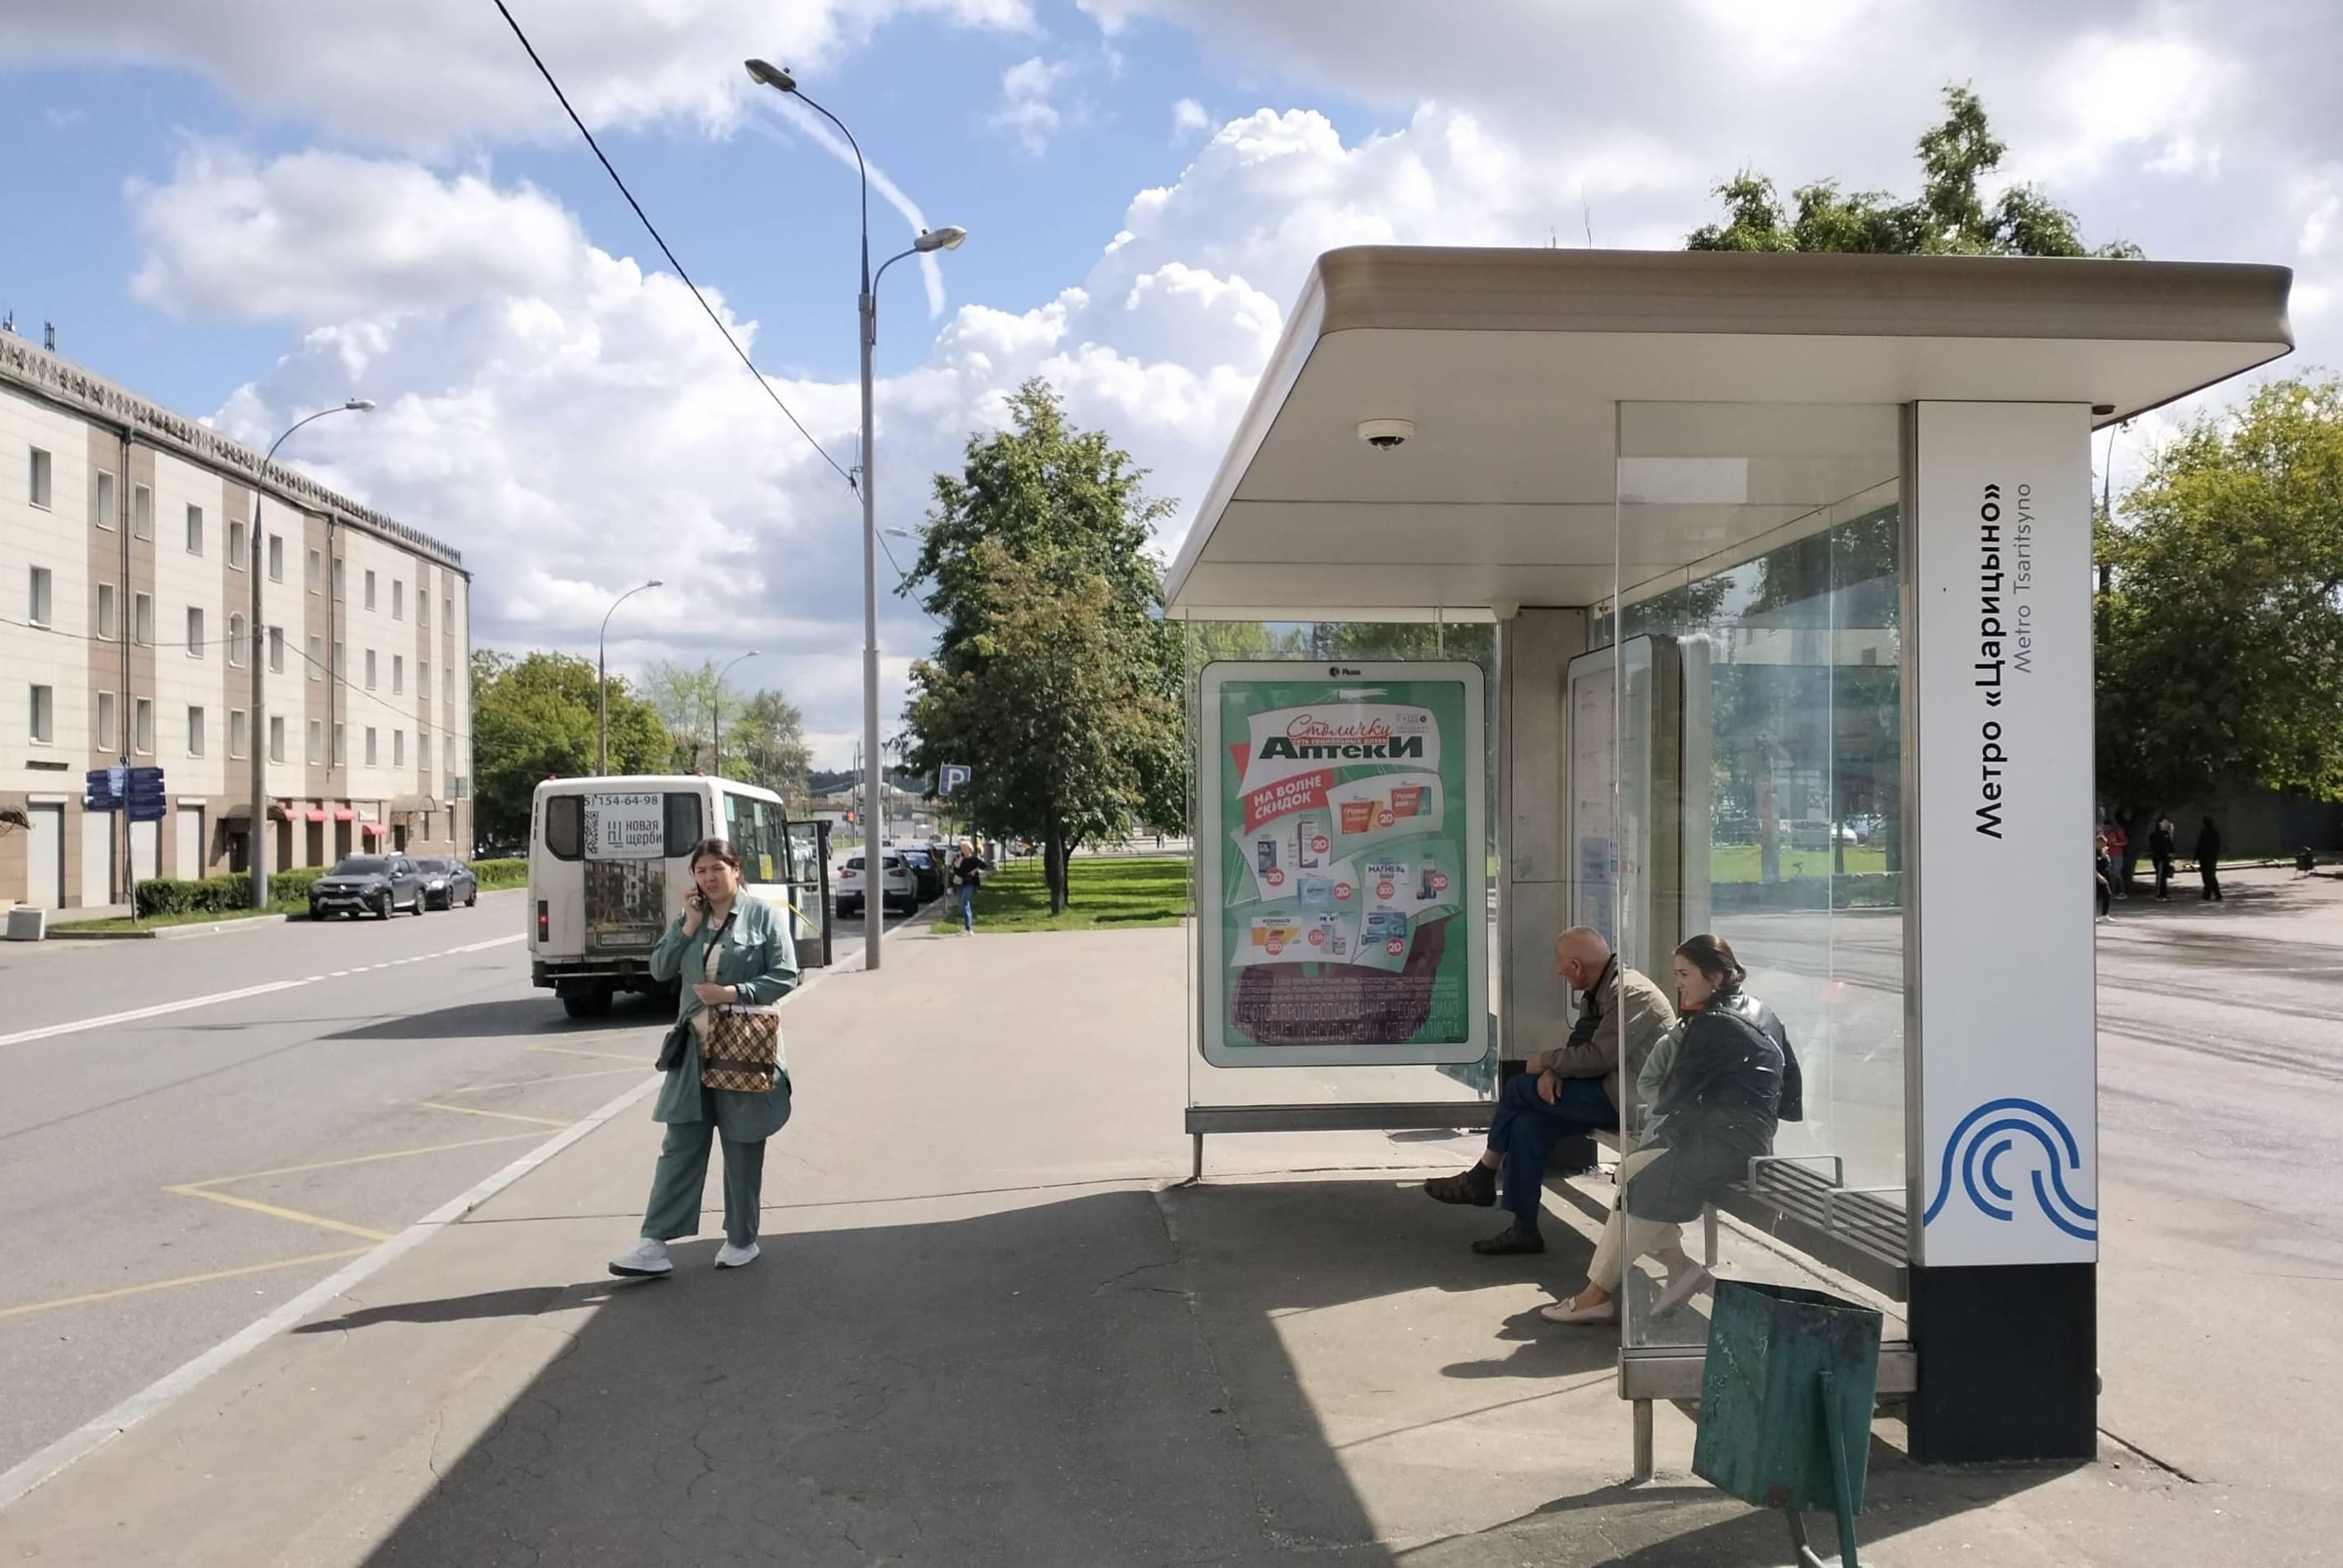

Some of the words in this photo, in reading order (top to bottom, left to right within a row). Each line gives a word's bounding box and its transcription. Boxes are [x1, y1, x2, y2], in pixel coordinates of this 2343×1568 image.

[2013, 483, 2036, 595] Tsaritsyno
[1974, 483, 2007, 707] «Царицыно»
[2014, 604, 2032, 674] Metro
[948, 768, 965, 791] P
[1975, 720, 2008, 839] Метро
[598, 795, 659, 805] 154-64-98
[1254, 791, 1273, 807] НА
[1276, 776, 1322, 797] ВОЛНЕ
[1254, 791, 1311, 819] СКИДОК
[1379, 813, 1393, 824] 20
[1312, 840, 1325, 850] 20
[1268, 874, 1282, 883] 20
[1335, 887, 1349, 896] 20
[1387, 942, 1401, 952] 20
